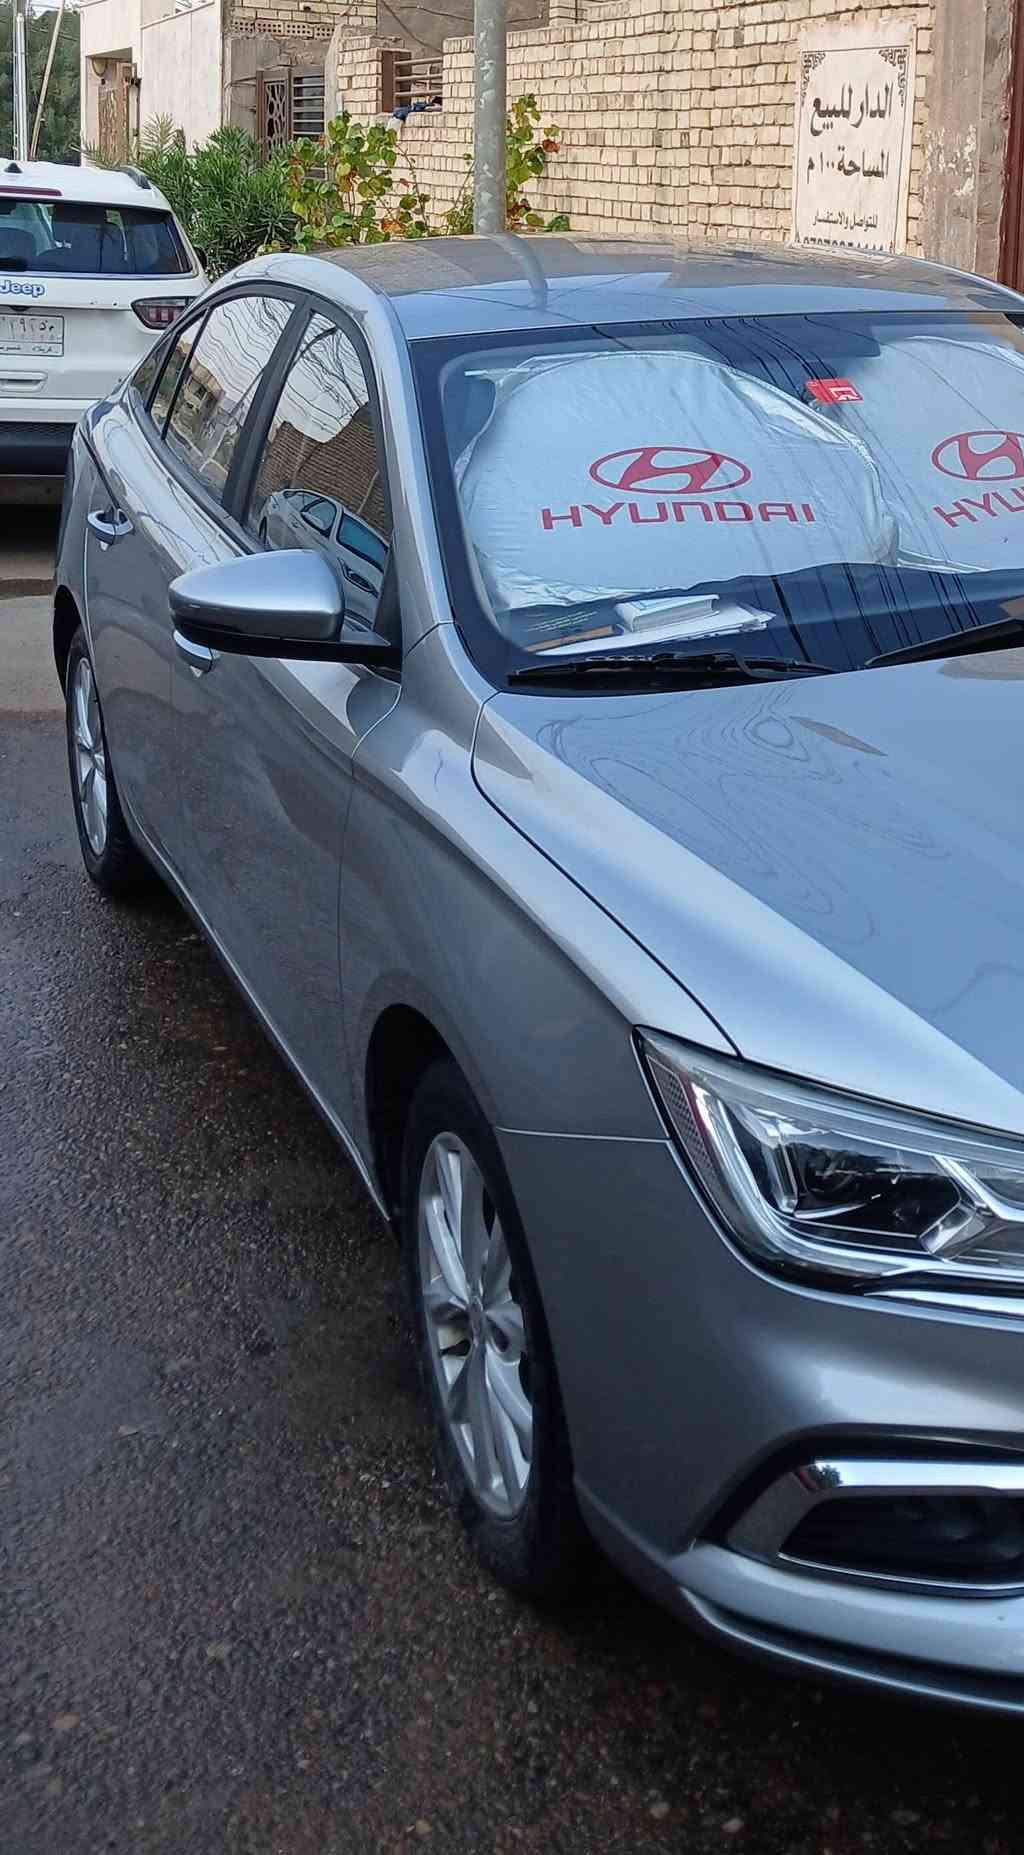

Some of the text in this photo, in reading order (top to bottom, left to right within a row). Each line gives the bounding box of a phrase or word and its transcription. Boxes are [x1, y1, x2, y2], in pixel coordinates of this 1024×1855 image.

[809, 81, 894, 137] الدار للبيع
[0, 279, 45, 298] Jeep
[540, 500, 816, 530] HYUNDAI
